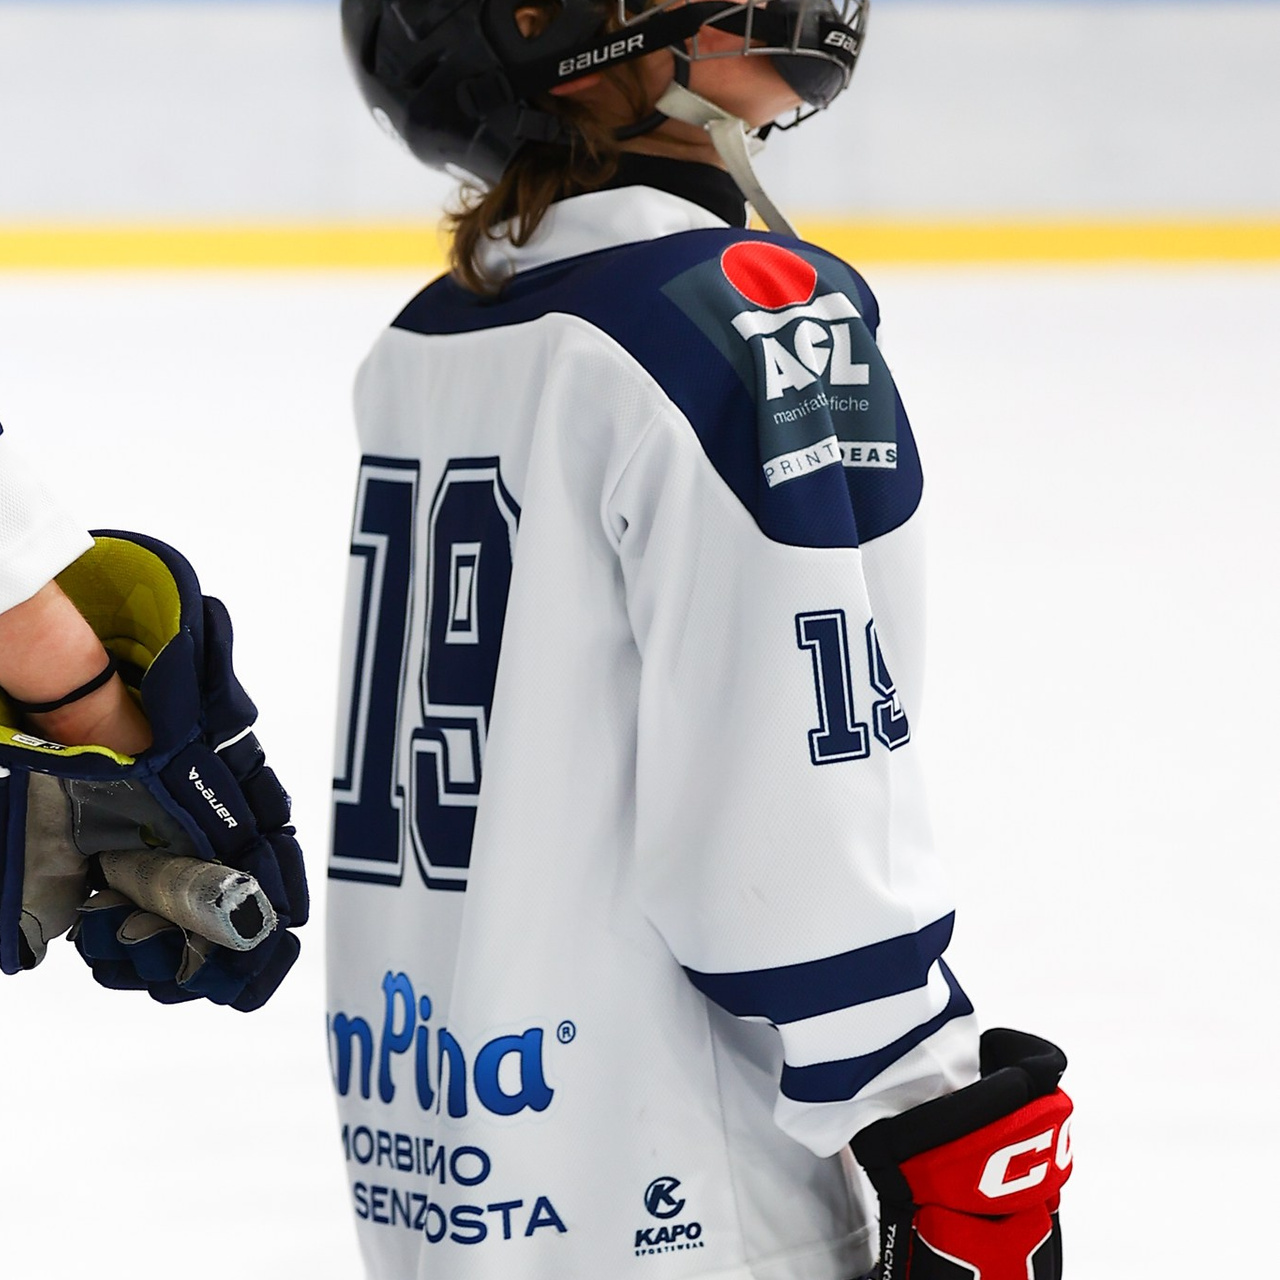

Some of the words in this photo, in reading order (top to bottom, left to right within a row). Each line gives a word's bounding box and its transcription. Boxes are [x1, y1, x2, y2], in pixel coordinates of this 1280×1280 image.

[558, 33, 644, 76] BAUER
[762, 320, 869, 401] AGL
[326, 454, 523, 893] 19
[796, 608, 911, 767] 19
[634, 1221, 702, 1248] KAPO
